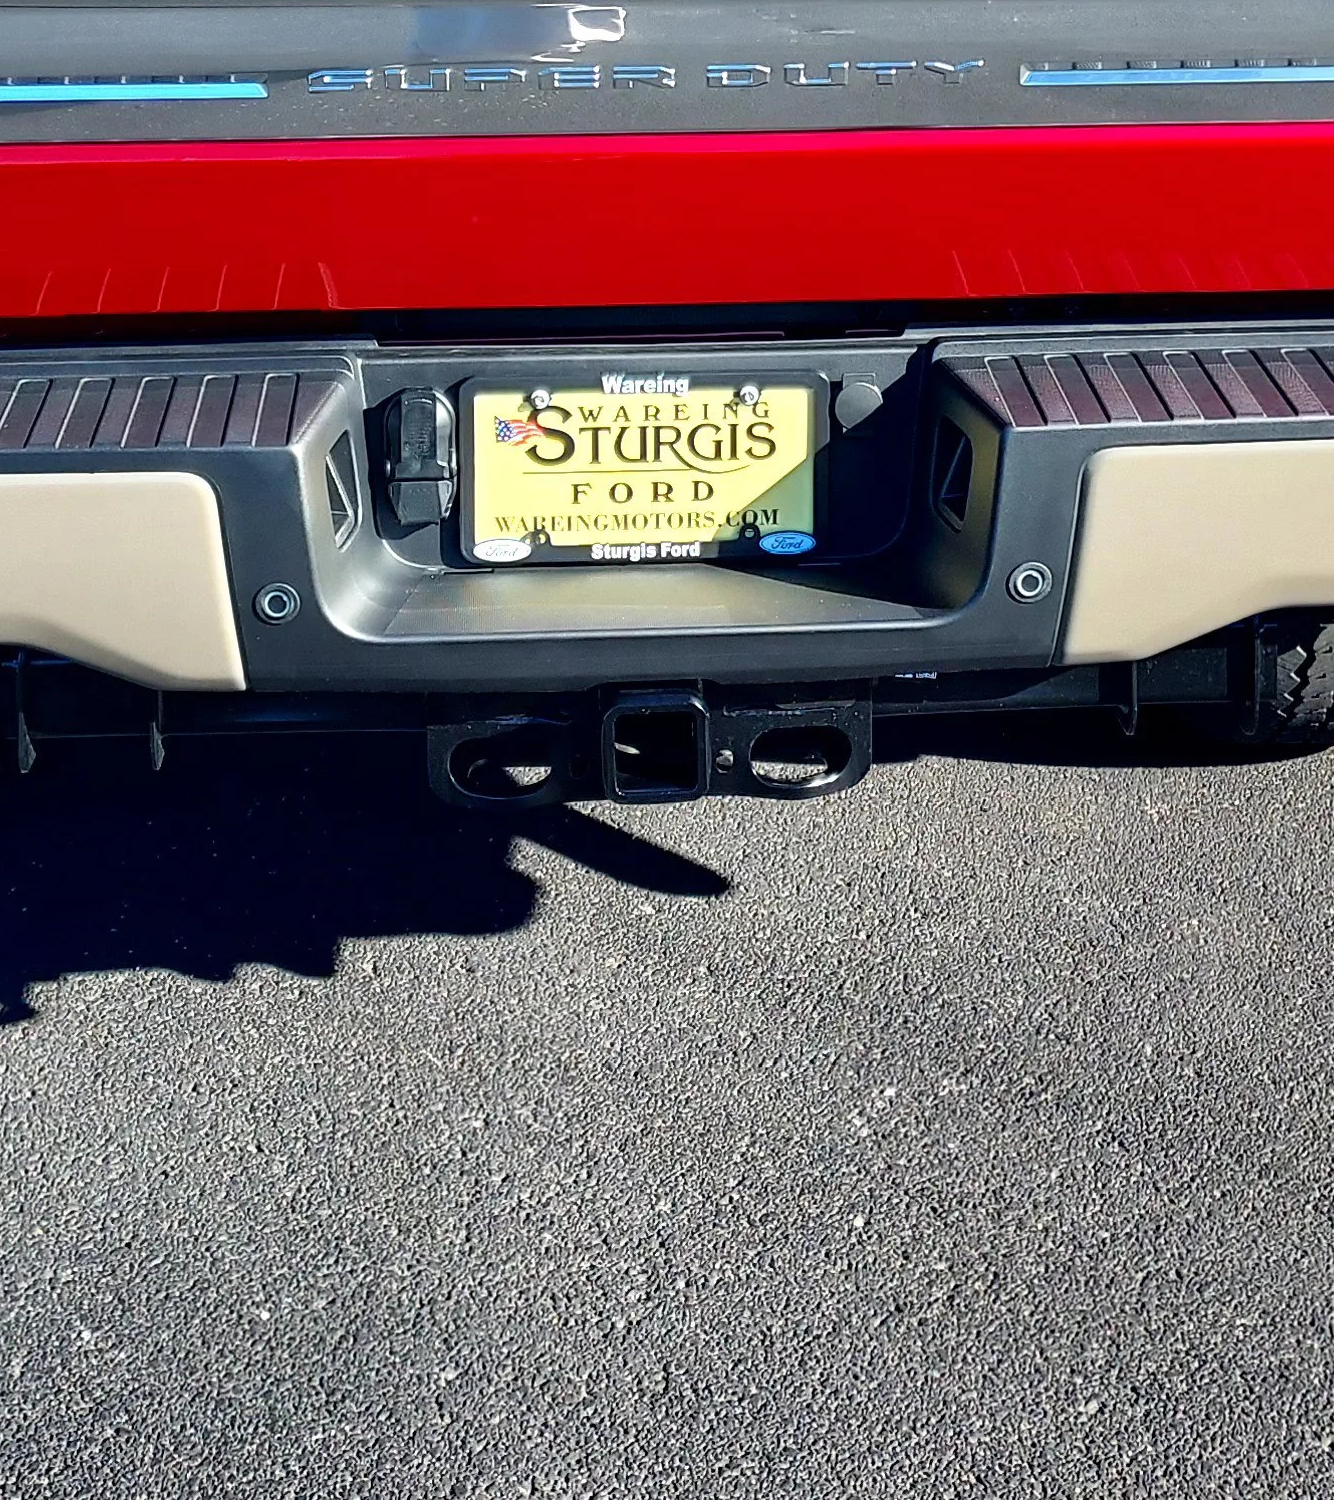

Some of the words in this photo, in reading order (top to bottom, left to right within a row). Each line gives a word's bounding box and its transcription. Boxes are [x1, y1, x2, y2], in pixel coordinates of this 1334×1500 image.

[308, 67, 677, 93] SUPER
[705, 61, 985, 91] DUTY
[602, 376, 689, 395] Wareing
[579, 401, 769, 422] WAREING
[524, 405, 777, 470] STURGIS
[571, 480, 715, 505] FORD
[494, 508, 779, 533] WAREINGMOTORS.COM
[591, 542, 656, 561] Sturgis
[660, 541, 701, 557] Ford
[771, 536, 804, 550] Ford
